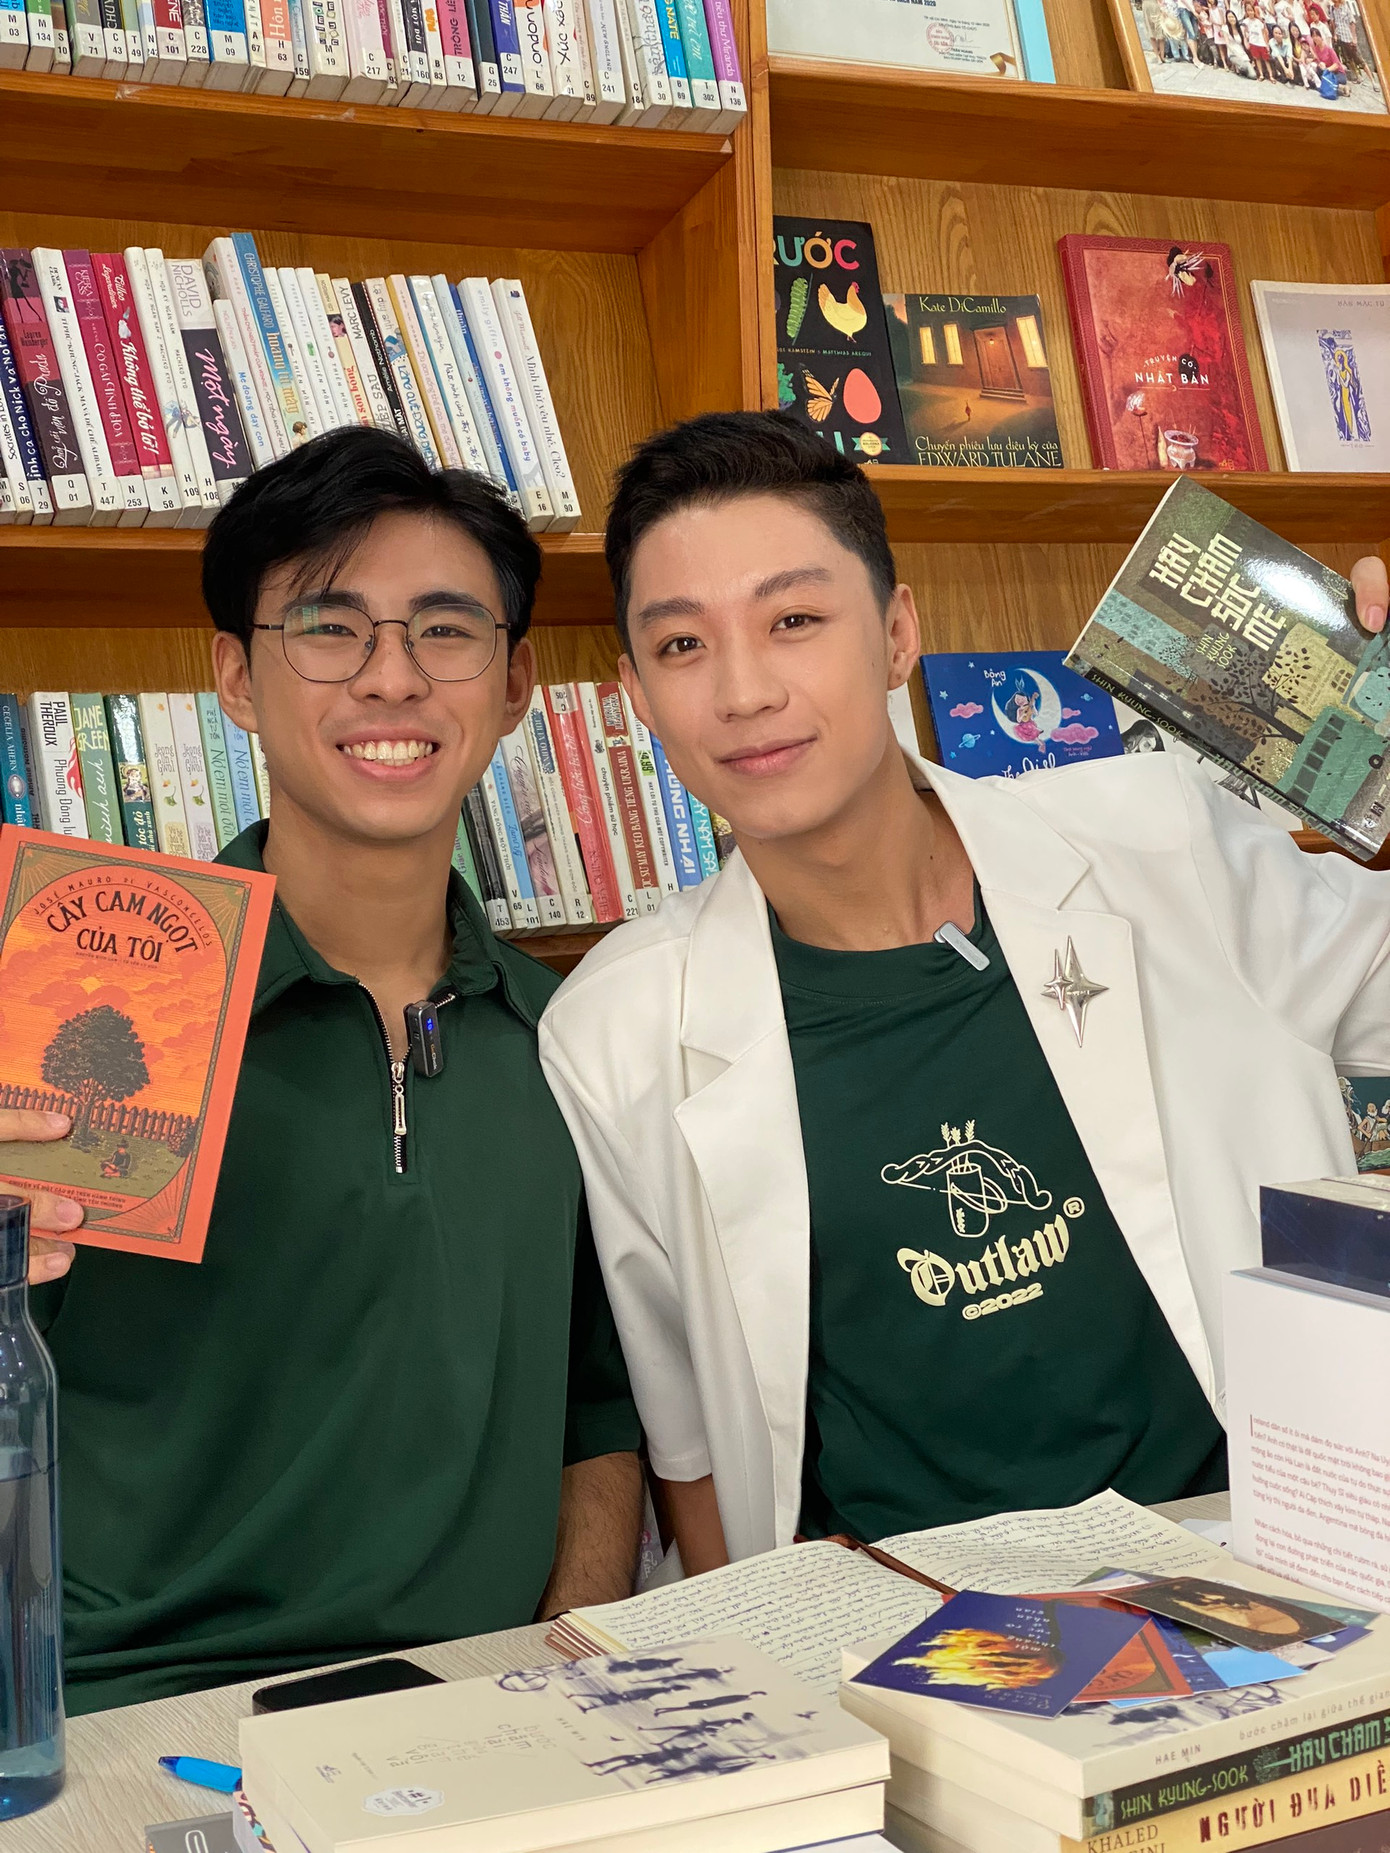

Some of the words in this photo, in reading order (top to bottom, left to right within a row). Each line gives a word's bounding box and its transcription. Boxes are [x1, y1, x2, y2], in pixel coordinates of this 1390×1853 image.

[666, 7, 681, 40] NATE
[9, 28, 20, 37] 03
[36, 32, 51, 42] 134
[57, 46, 68, 55] 10
[88, 46, 99, 55] 71
[112, 46, 123, 55] 43
[131, 48, 142, 57] 49
[165, 45, 180, 54] 101
[191, 45, 207, 54] 228
[225, 48, 236, 56] 09
[277, 54, 288, 62] 63
[326, 57, 336, 66] 19
[722, 39, 736, 77] Miranda
[294, 67, 310, 76] 159
[366, 66, 381, 75] 217
[457, 73, 466, 82] 12
[503, 66, 518, 75] 247
[487, 78, 498, 87] 25
[602, 83, 615, 93] 241
[702, 93, 715, 101] 302
[243, 252, 266, 297] CHRISTOPHE
[75, 271, 87, 296] CASS
[80, 269, 94, 297] KIERA
[171, 264, 193, 317] NICHOLLS
[180, 265, 202, 309] DAVID
[338, 286, 356, 311] LEVY
[477, 289, 490, 316] emily
[919, 296, 946, 314] Kate
[949, 297, 1008, 315] DiCamillo
[347, 312, 363, 339] MARC
[483, 320, 498, 347] giffin
[120, 341, 140, 386] Không
[498, 362, 506, 375] em
[195, 348, 230, 407] Một
[1134, 371, 1174, 385] NHẬT
[1181, 372, 1210, 386] BẢN
[367, 374, 383, 400] SAU
[502, 377, 514, 403] không
[8, 386, 25, 414] Nick
[130, 386, 151, 413] thể
[136, 411, 155, 430] bỏ
[525, 354, 540, 382] Mình
[550, 450, 566, 479] Cleo?
[18, 416, 30, 437] cho
[517, 429, 526, 439] có
[3, 423, 18, 460] Socrates
[205, 404, 239, 469] ngày
[255, 431, 264, 447] con
[26, 440, 36, 454] ca
[520, 441, 531, 462] baby
[914, 435, 956, 453] Chuyến
[959, 439, 985, 454] phiêu
[986, 439, 1004, 451] lưu
[1005, 440, 1026, 453] diệu
[1027, 440, 1040, 453] kỳ
[1041, 442, 1059, 451] của
[918, 452, 989, 468] EDWARD
[991, 450, 1062, 468] TULANE
[67, 480, 75, 489] Q
[184, 474, 192, 483] H
[18, 482, 25, 491] S
[37, 487, 43, 496] T
[101, 482, 107, 491] T
[128, 485, 136, 494] N
[161, 486, 169, 495] K
[183, 488, 200, 497] 109
[19, 496, 30, 505] 06
[69, 493, 78, 501] 01
[100, 495, 115, 505] 447
[535, 491, 542, 499] E
[561, 491, 569, 499] M
[38, 501, 49, 509] 29
[126, 498, 142, 508] 253
[162, 500, 175, 509] 58
[538, 503, 547, 512] 16
[563, 504, 573, 512] 90
[1195, 633, 1214, 655] SHIN
[1206, 632, 1230, 662] KYUNG
[1216, 644, 1238, 669] SOOK
[991, 679, 1003, 688] An
[1091, 673, 1116, 697] SHIN
[1117, 691, 1185, 739] KYUNG-SOOK
[52, 701, 68, 727] PAUL
[73, 705, 103, 731] JANE
[2, 704, 14, 741] CECELIA
[39, 701, 58, 747] THEROUX
[77, 729, 110, 752] GREEN
[7, 742, 18, 772] AHERN
[616, 750, 632, 786] UKRAINA
[87, 759, 108, 795] anh
[214, 770, 228, 791] em
[237, 770, 249, 790] em
[59, 797, 73, 824] Đông
[132, 810, 145, 825] đỏ
[137, 828, 147, 845] tóc
[676, 823, 696, 874] NHẠI
[511, 889, 518, 898] V
[627, 894, 633, 903] C
[646, 891, 652, 900] L
[513, 902, 523, 910] 65
[549, 898, 555, 907] C
[575, 898, 581, 907] R
[646, 903, 655, 912] 01
[33, 890, 59, 916] JOSÉ
[67, 876, 112, 892] MAURO
[146, 882, 213, 947] VASCONCELOS
[548, 911, 562, 919] 140
[576, 910, 585, 919] 12
[625, 907, 639, 917] 221
[46, 895, 88, 933] CÂY
[95, 890, 147, 916] CAM
[146, 902, 199, 954] NGỌT
[76, 926, 118, 956] CỦA
[127, 935, 164, 963] TÔI
[1155, 1751, 1176, 1766] HAE
[1181, 1744, 1201, 1759] MIN
[1120, 1793, 1153, 1820] SHIN
[1157, 1765, 1249, 1806] KYUNG-SOOK
[1199, 1797, 1275, 1844] NGƯỜI
[1086, 1824, 1159, 1853] KHALED
